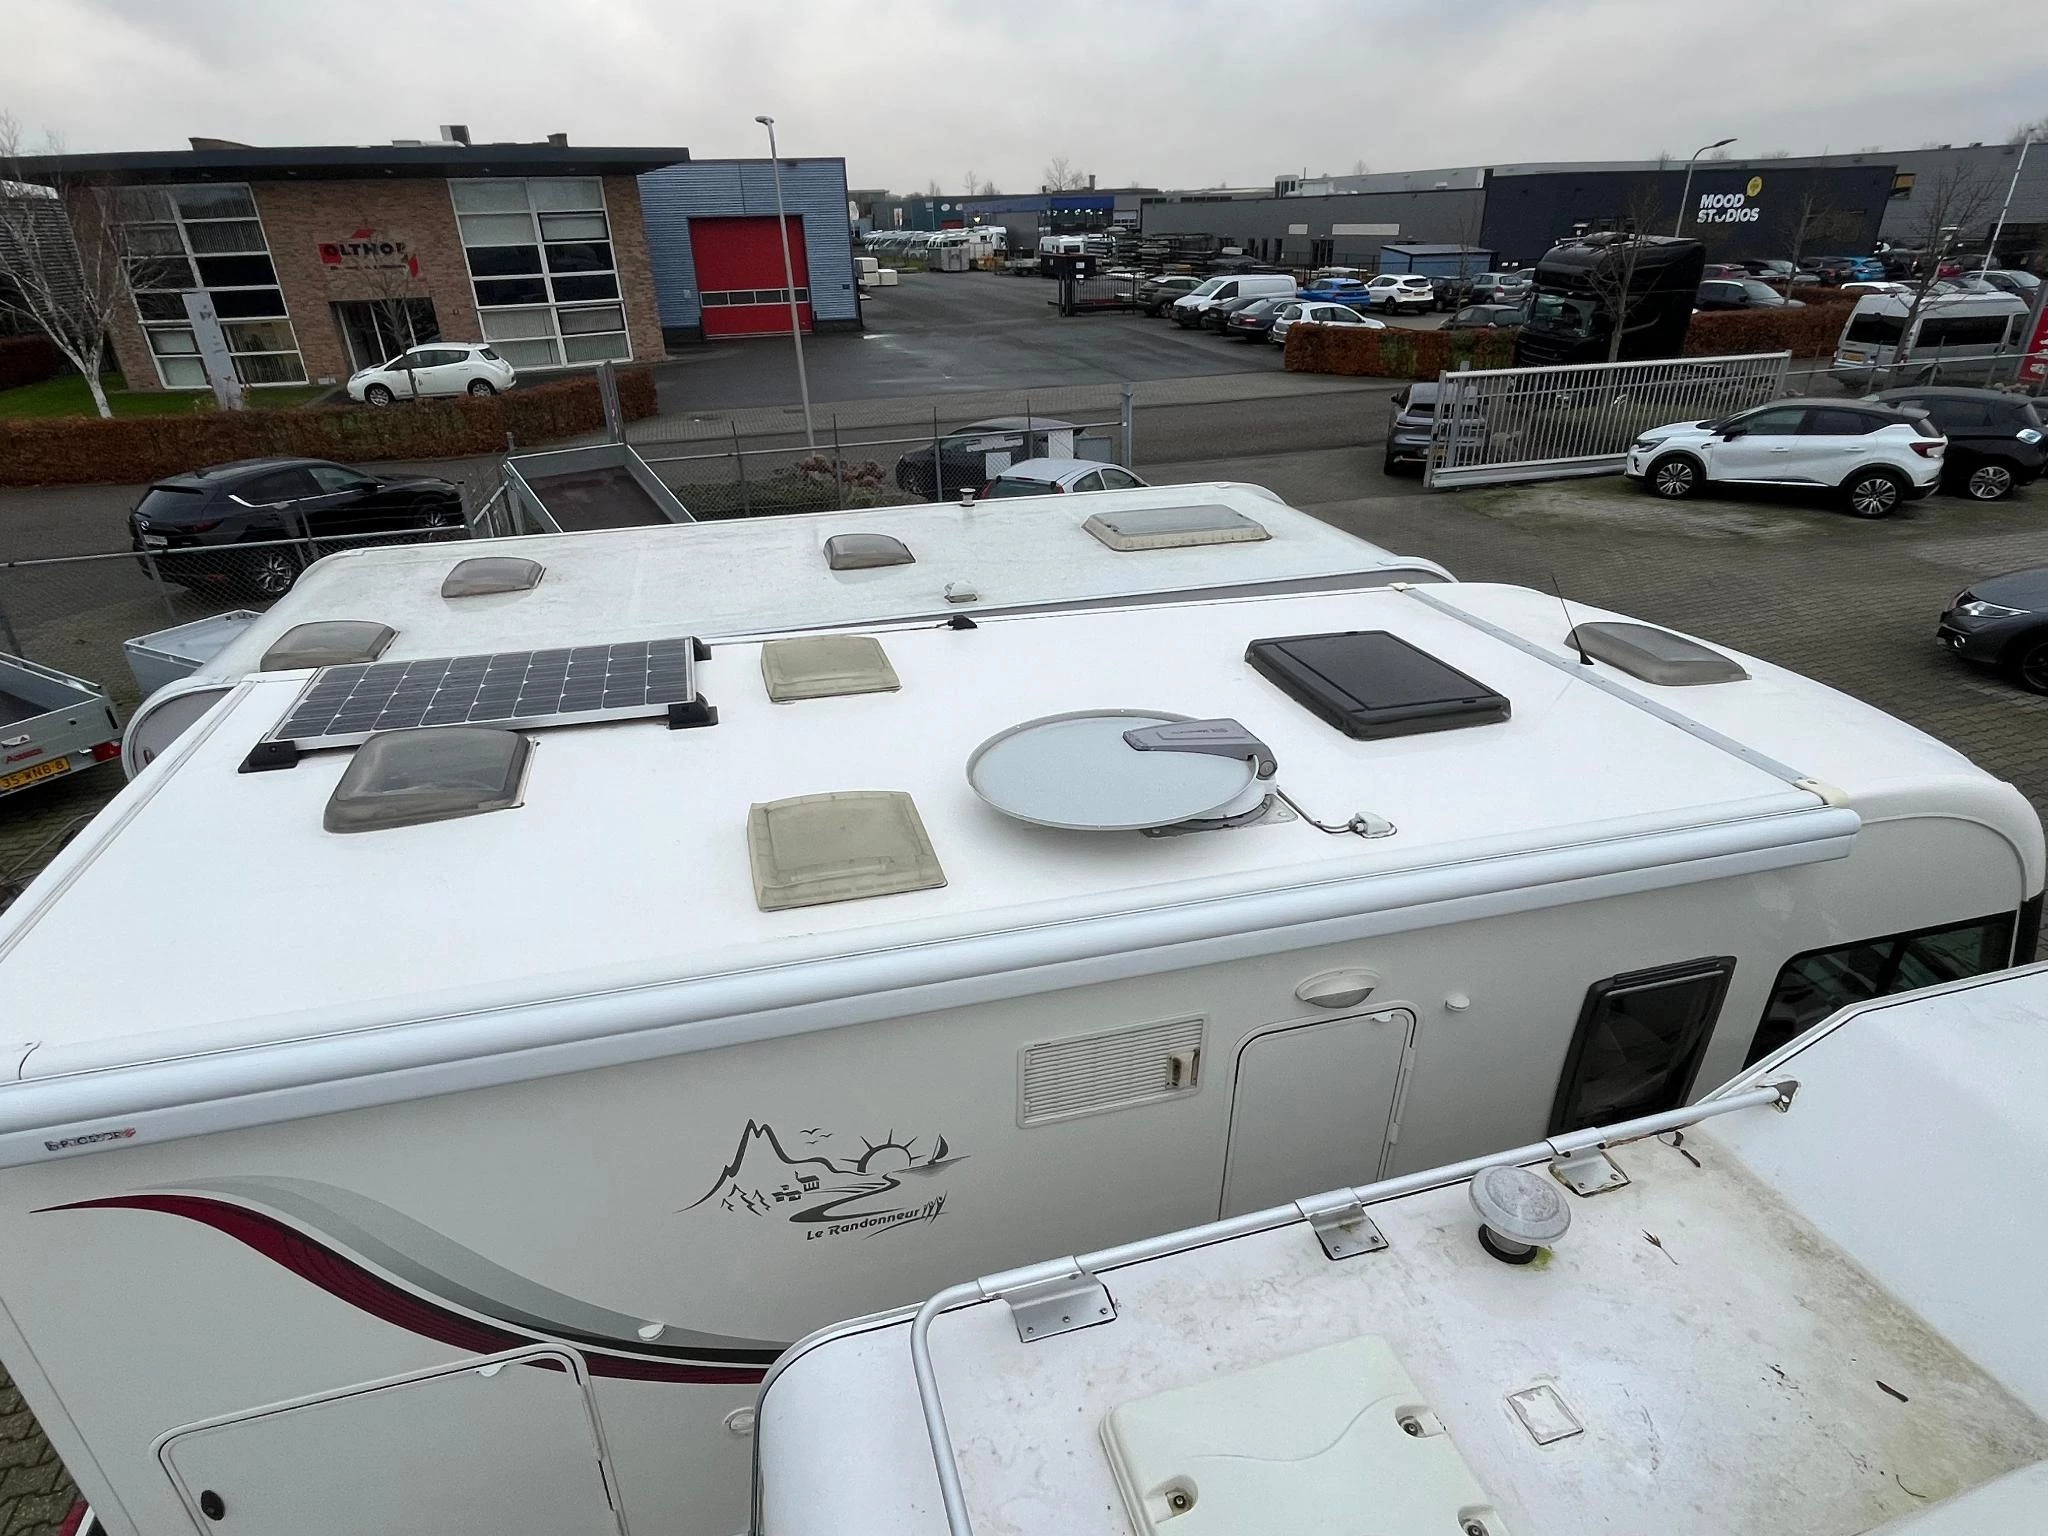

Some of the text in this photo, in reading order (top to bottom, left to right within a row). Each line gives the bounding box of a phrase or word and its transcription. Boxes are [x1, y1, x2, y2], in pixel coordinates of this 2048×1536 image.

[1699, 193, 1745, 209] MOOD
[1696, 207, 1760, 223] STUDIOS
[806, 1208, 921, 1241] Le Randonneur
